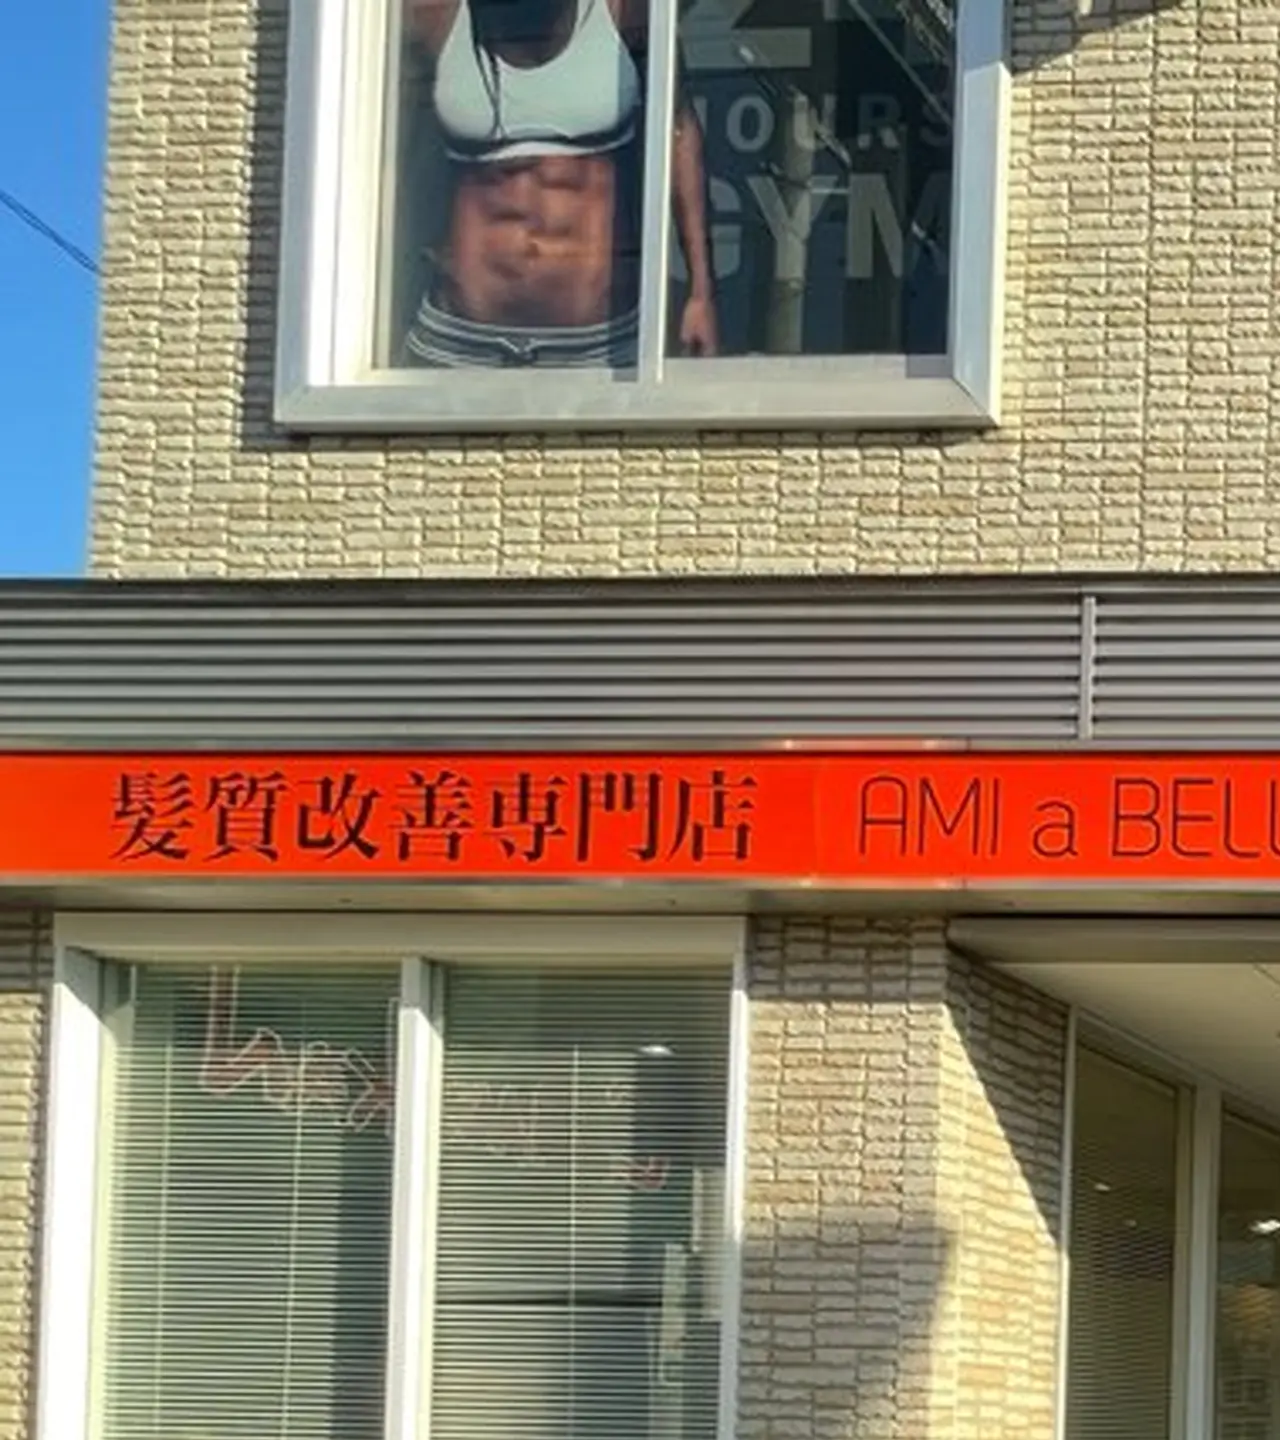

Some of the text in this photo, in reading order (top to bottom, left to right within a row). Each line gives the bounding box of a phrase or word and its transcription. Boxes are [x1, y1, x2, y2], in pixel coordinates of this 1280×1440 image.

[111, 769, 758, 864] 髪質改善専門店
[858, 776, 999, 858] AMI
[1032, 800, 1078, 858] a
